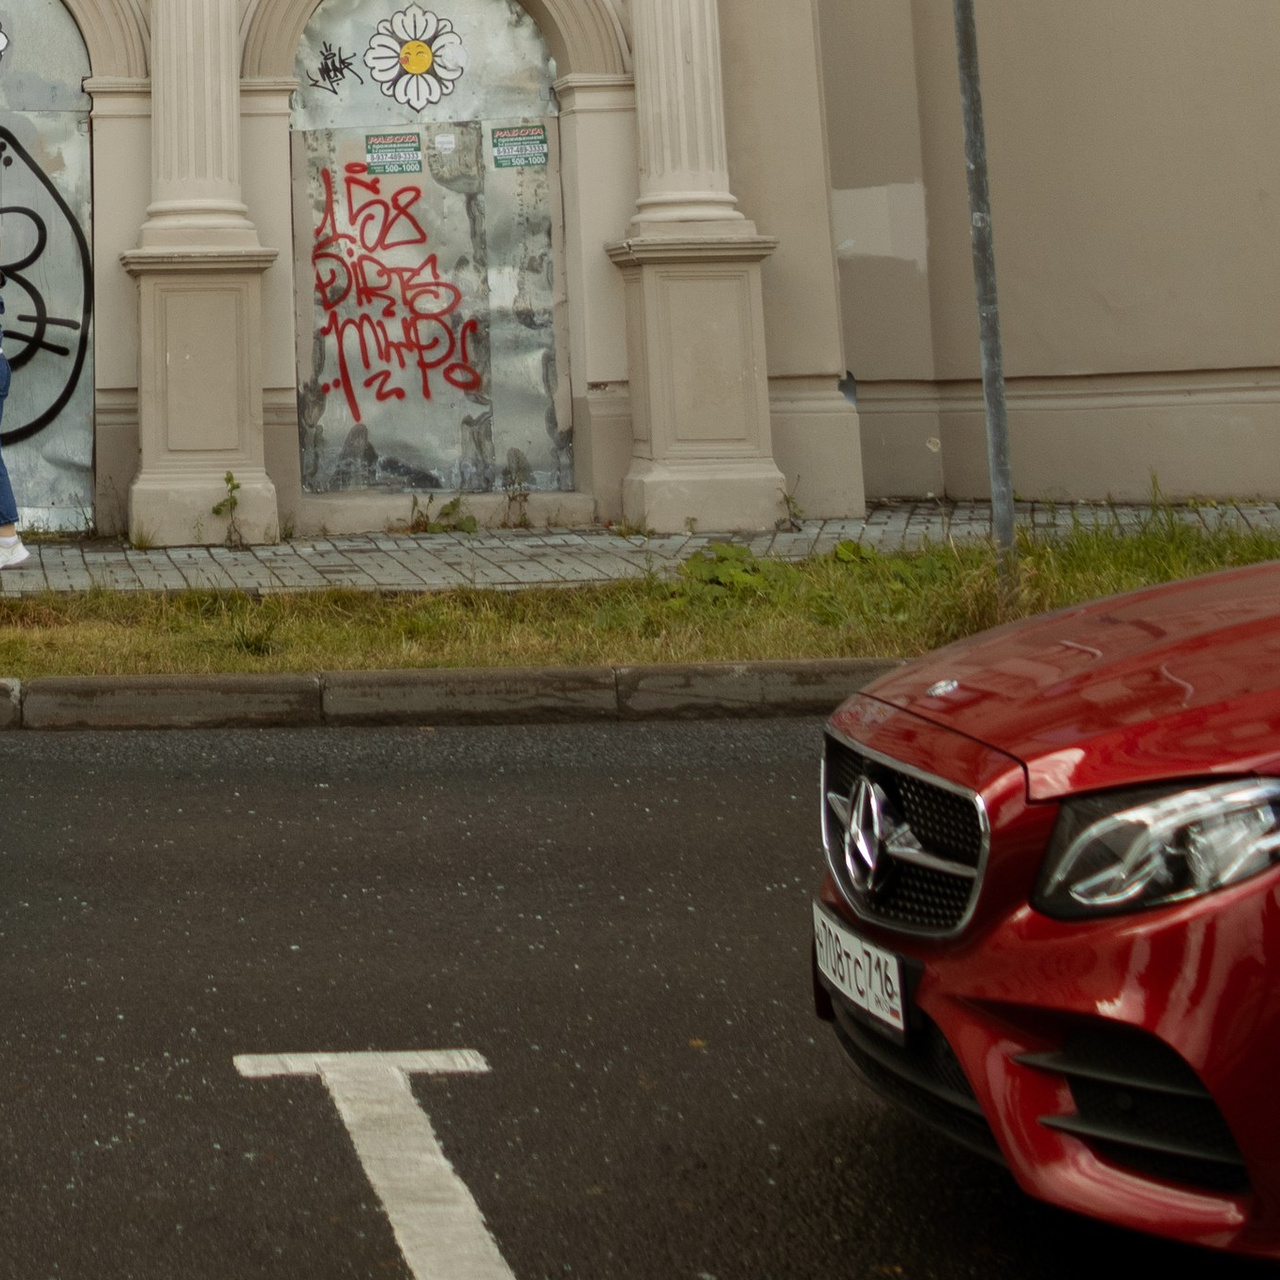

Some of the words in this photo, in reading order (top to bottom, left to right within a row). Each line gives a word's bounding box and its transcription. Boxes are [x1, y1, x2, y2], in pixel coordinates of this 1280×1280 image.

[494, 128, 542, 138] РАБОТА
[368, 135, 418, 144] РАБОТА
[511, 156, 546, 166] 500-1000
[385, 164, 420, 172] 500-1000
[862, 948, 895, 1002] 716
